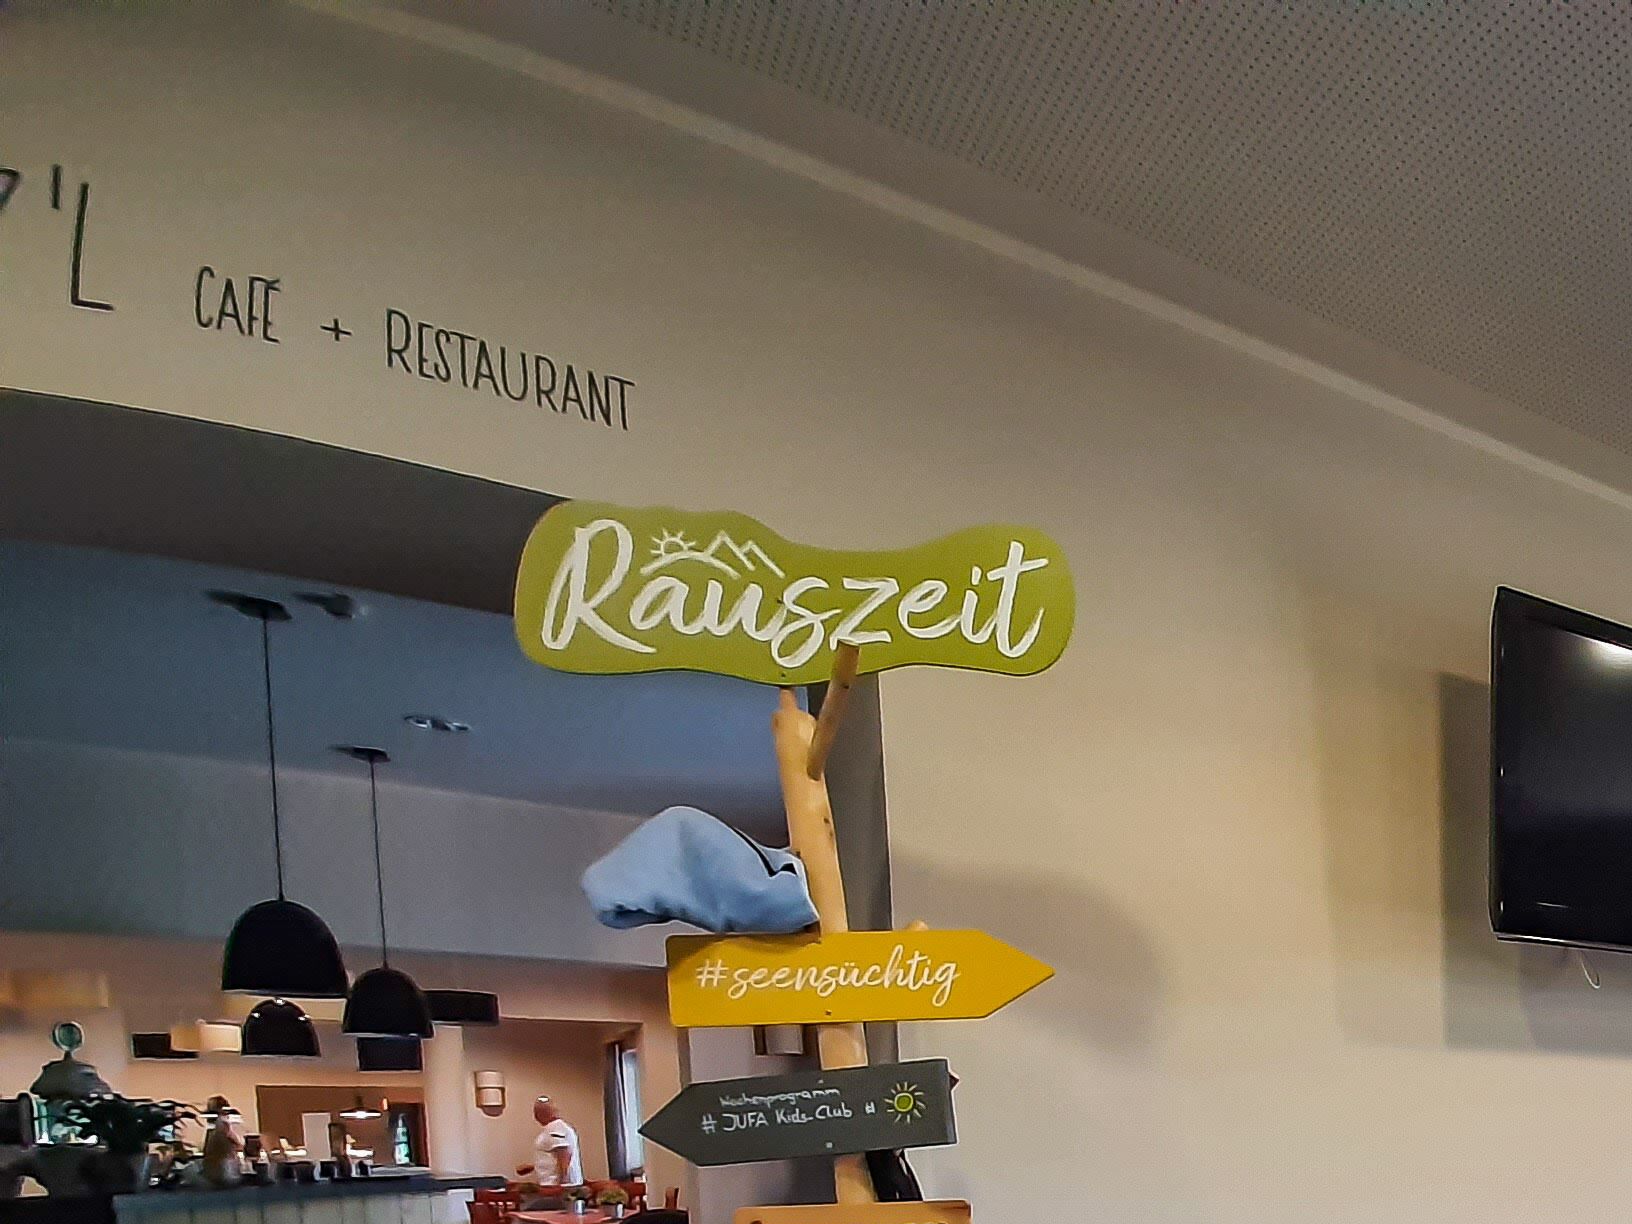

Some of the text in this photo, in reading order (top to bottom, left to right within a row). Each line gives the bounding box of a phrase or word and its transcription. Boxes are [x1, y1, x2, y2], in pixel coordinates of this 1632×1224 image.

[385, 307, 636, 431] RESTAURANT
[541, 519, 1049, 668] Rauszeit
[696, 944, 961, 1007] #seensüchtig
[722, 1112, 769, 1132] JUFA
[816, 1102, 852, 1120] Club
